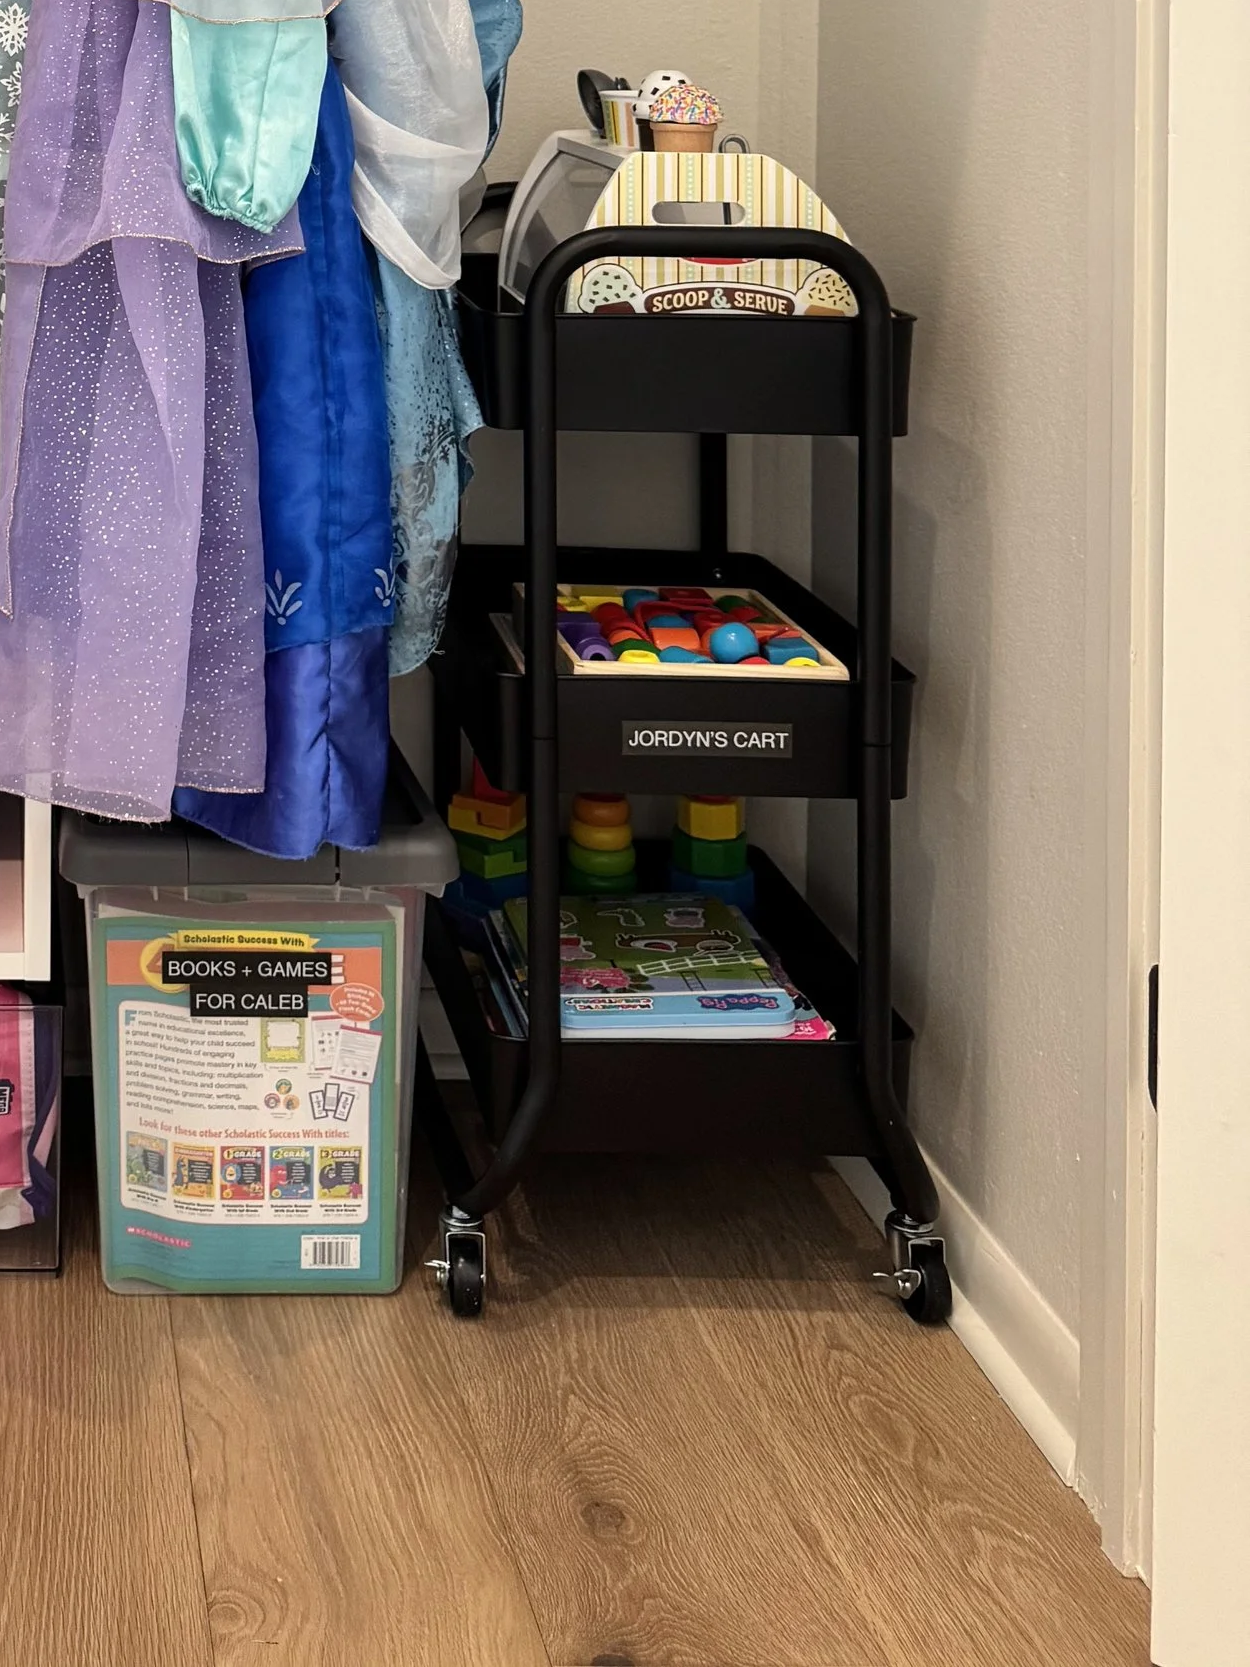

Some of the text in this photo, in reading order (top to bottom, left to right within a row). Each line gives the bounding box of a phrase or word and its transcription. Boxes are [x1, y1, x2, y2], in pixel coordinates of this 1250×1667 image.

[652, 290, 709, 312] SCOOP
[710, 288, 732, 309] &
[629, 731, 788, 748] JORDYN'S CART
[184, 934, 305, 947] Scholastic Success With
[168, 961, 235, 976] BOOKS
[242, 966, 252, 977] +
[258, 962, 327, 977] GAMES
[196, 994, 304, 1010] FOR CALEB
[726, 995, 777, 1008] Peppa
[139, 1117, 350, 1139] Look for these other Scholastic Success With titles:
[135, 1228, 191, 1248] SCHOLASTIC
